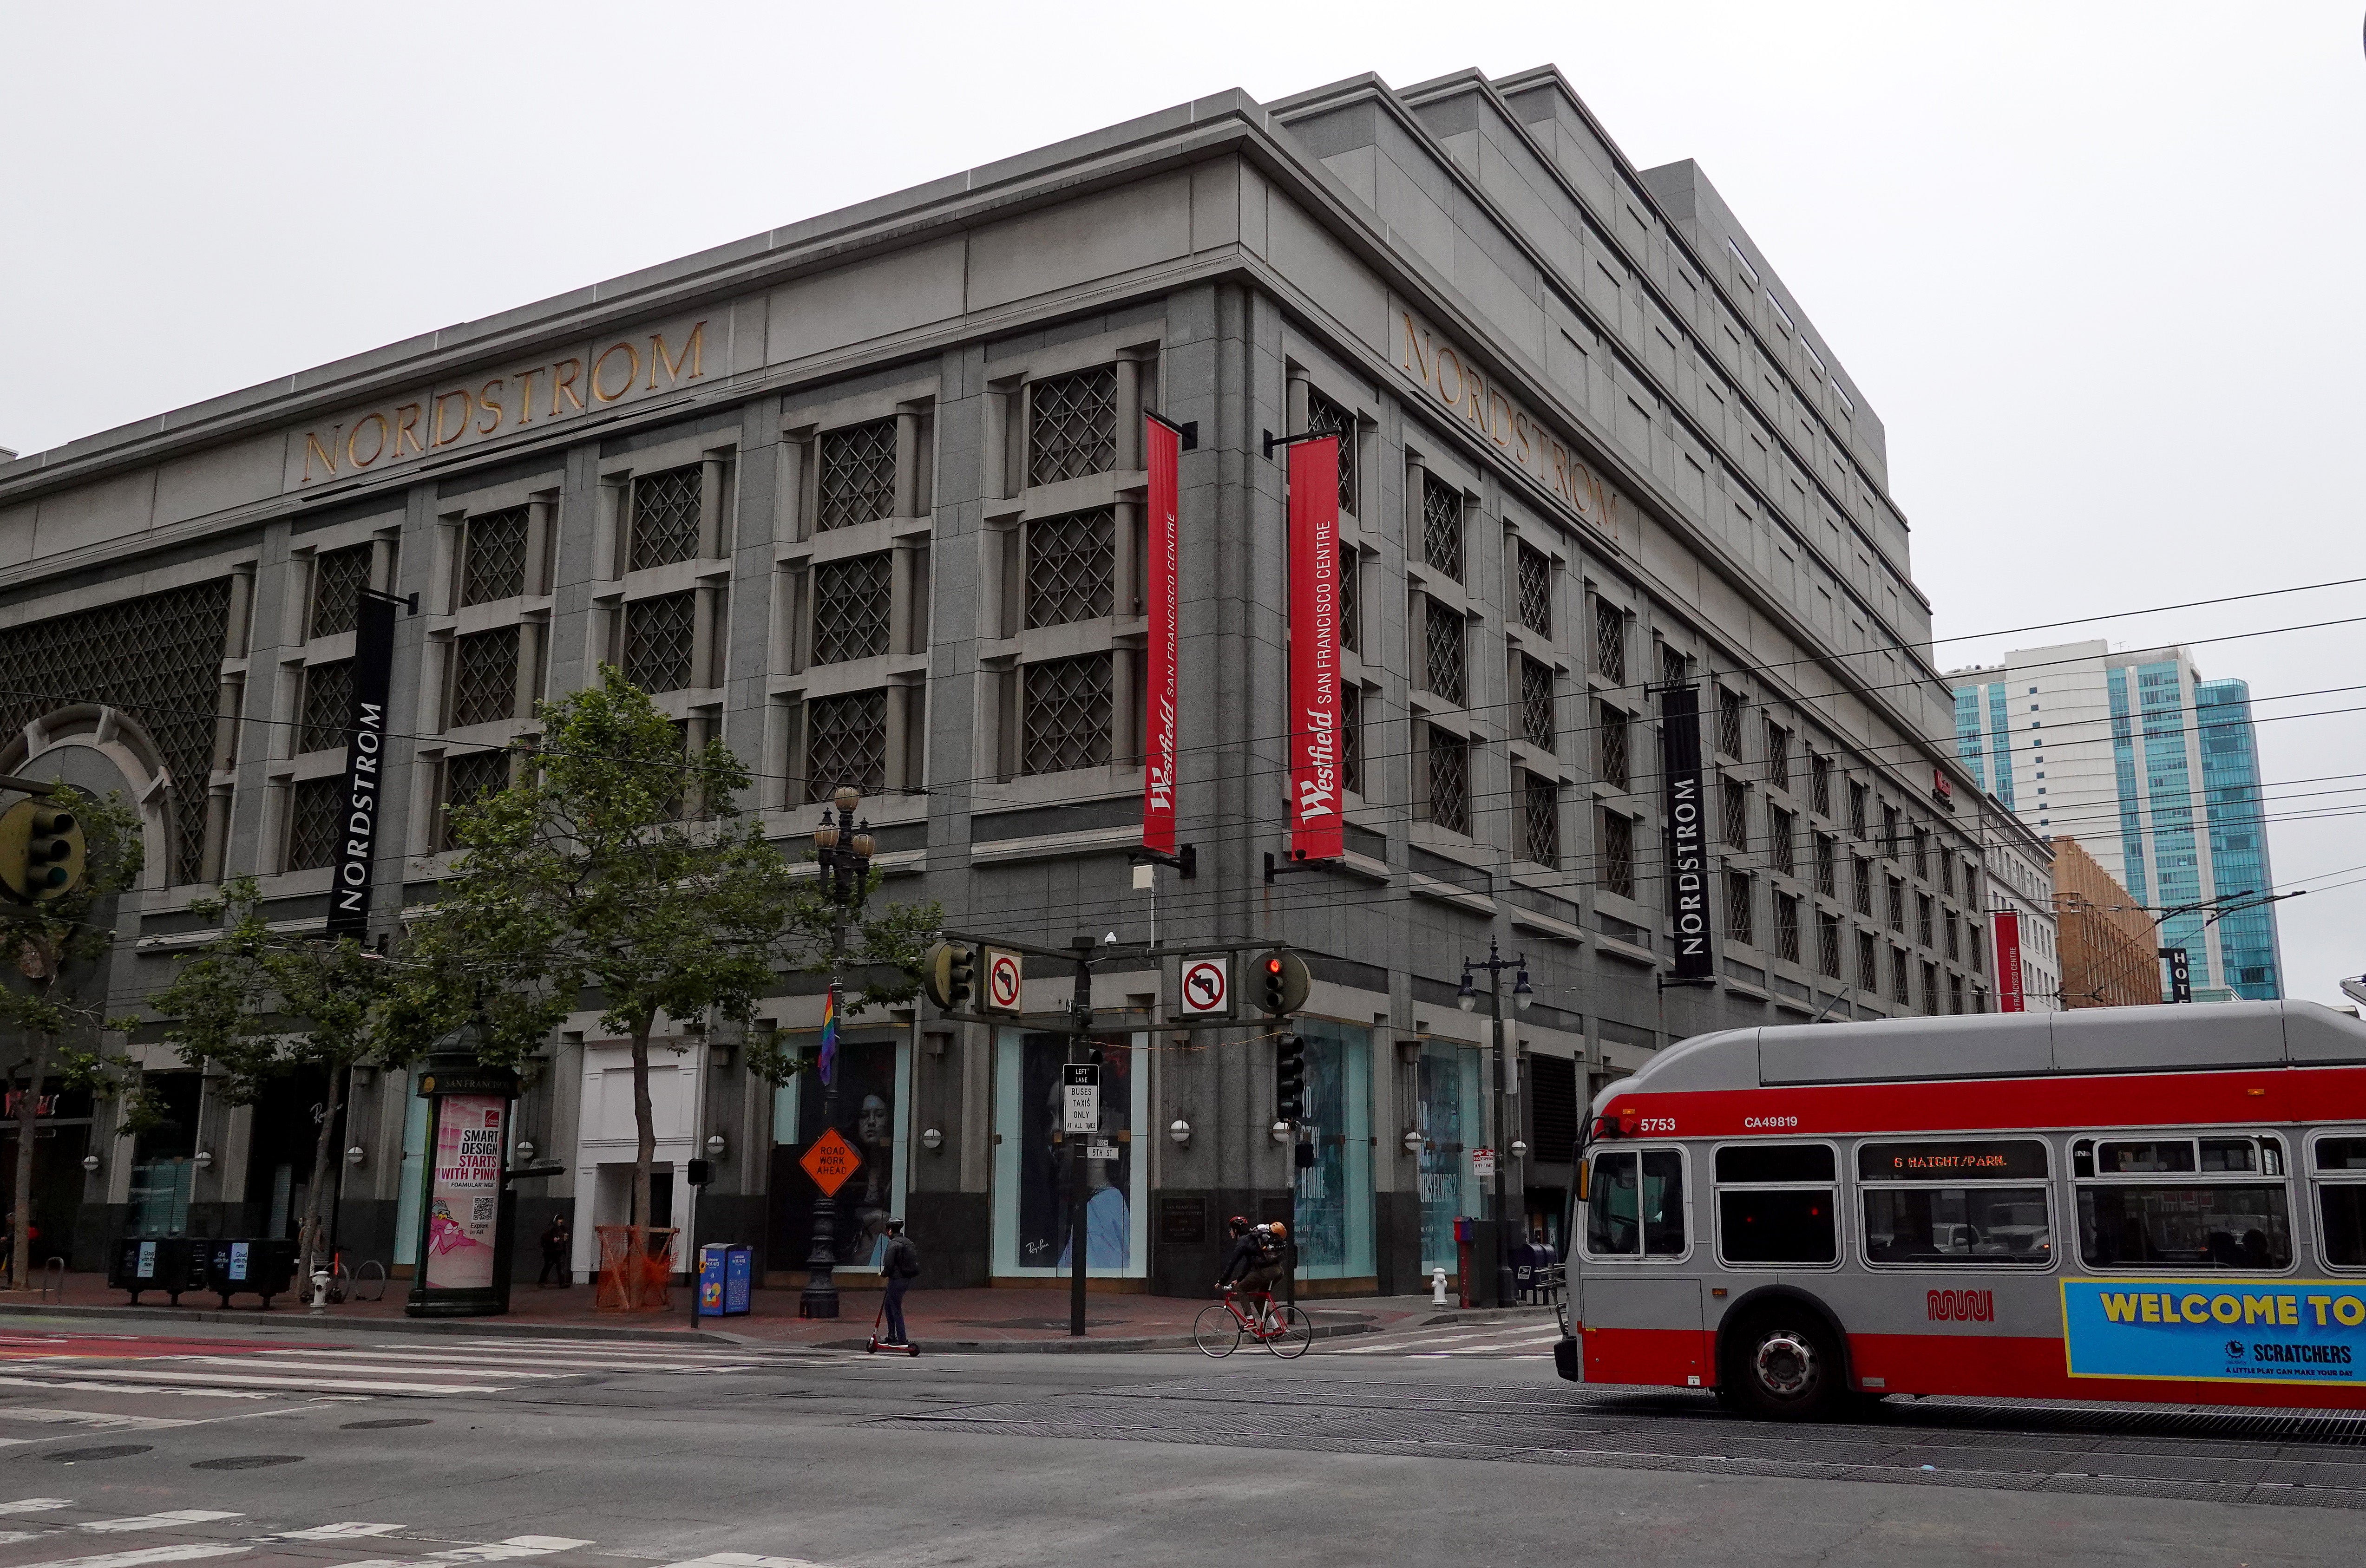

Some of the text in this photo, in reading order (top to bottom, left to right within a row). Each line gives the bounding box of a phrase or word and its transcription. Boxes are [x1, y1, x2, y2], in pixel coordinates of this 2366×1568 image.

[302, 320, 707, 482] NORDSTROM
[1403, 311, 1619, 540] NORDSTROM
[1300, 521, 1334, 825] Westfield SAN FRANCISCO CENTRE
[1150, 694, 1173, 812] Westfield
[339, 703, 381, 911] NORDSTROM
[1674, 778, 1703, 954] NORDSTROM
[2009, 947, 2018, 970] CENTRE
[2012, 972, 2021, 1006] FRANCISCO
[1641, 1118, 1676, 1131] 5753
[1744, 1116, 1798, 1128] CA49819
[464, 1130, 498, 1143] SMART
[462, 1143, 498, 1155] DESIGN
[820, 1156, 844, 1165] WORK
[459, 1156, 497, 1168] STARTS
[817, 1166, 846, 1175] AHEAD
[1894, 1157, 1903, 1168] 6
[442, 1168, 496, 1180] WITH PINK
[1301, 1167, 1325, 1199] HOME
[1420, 1173, 1457, 1203] URSELVES?
[2100, 1292, 2366, 1326] WELCOME TO
[2253, 1344, 2352, 1364] SCRATCHERS
